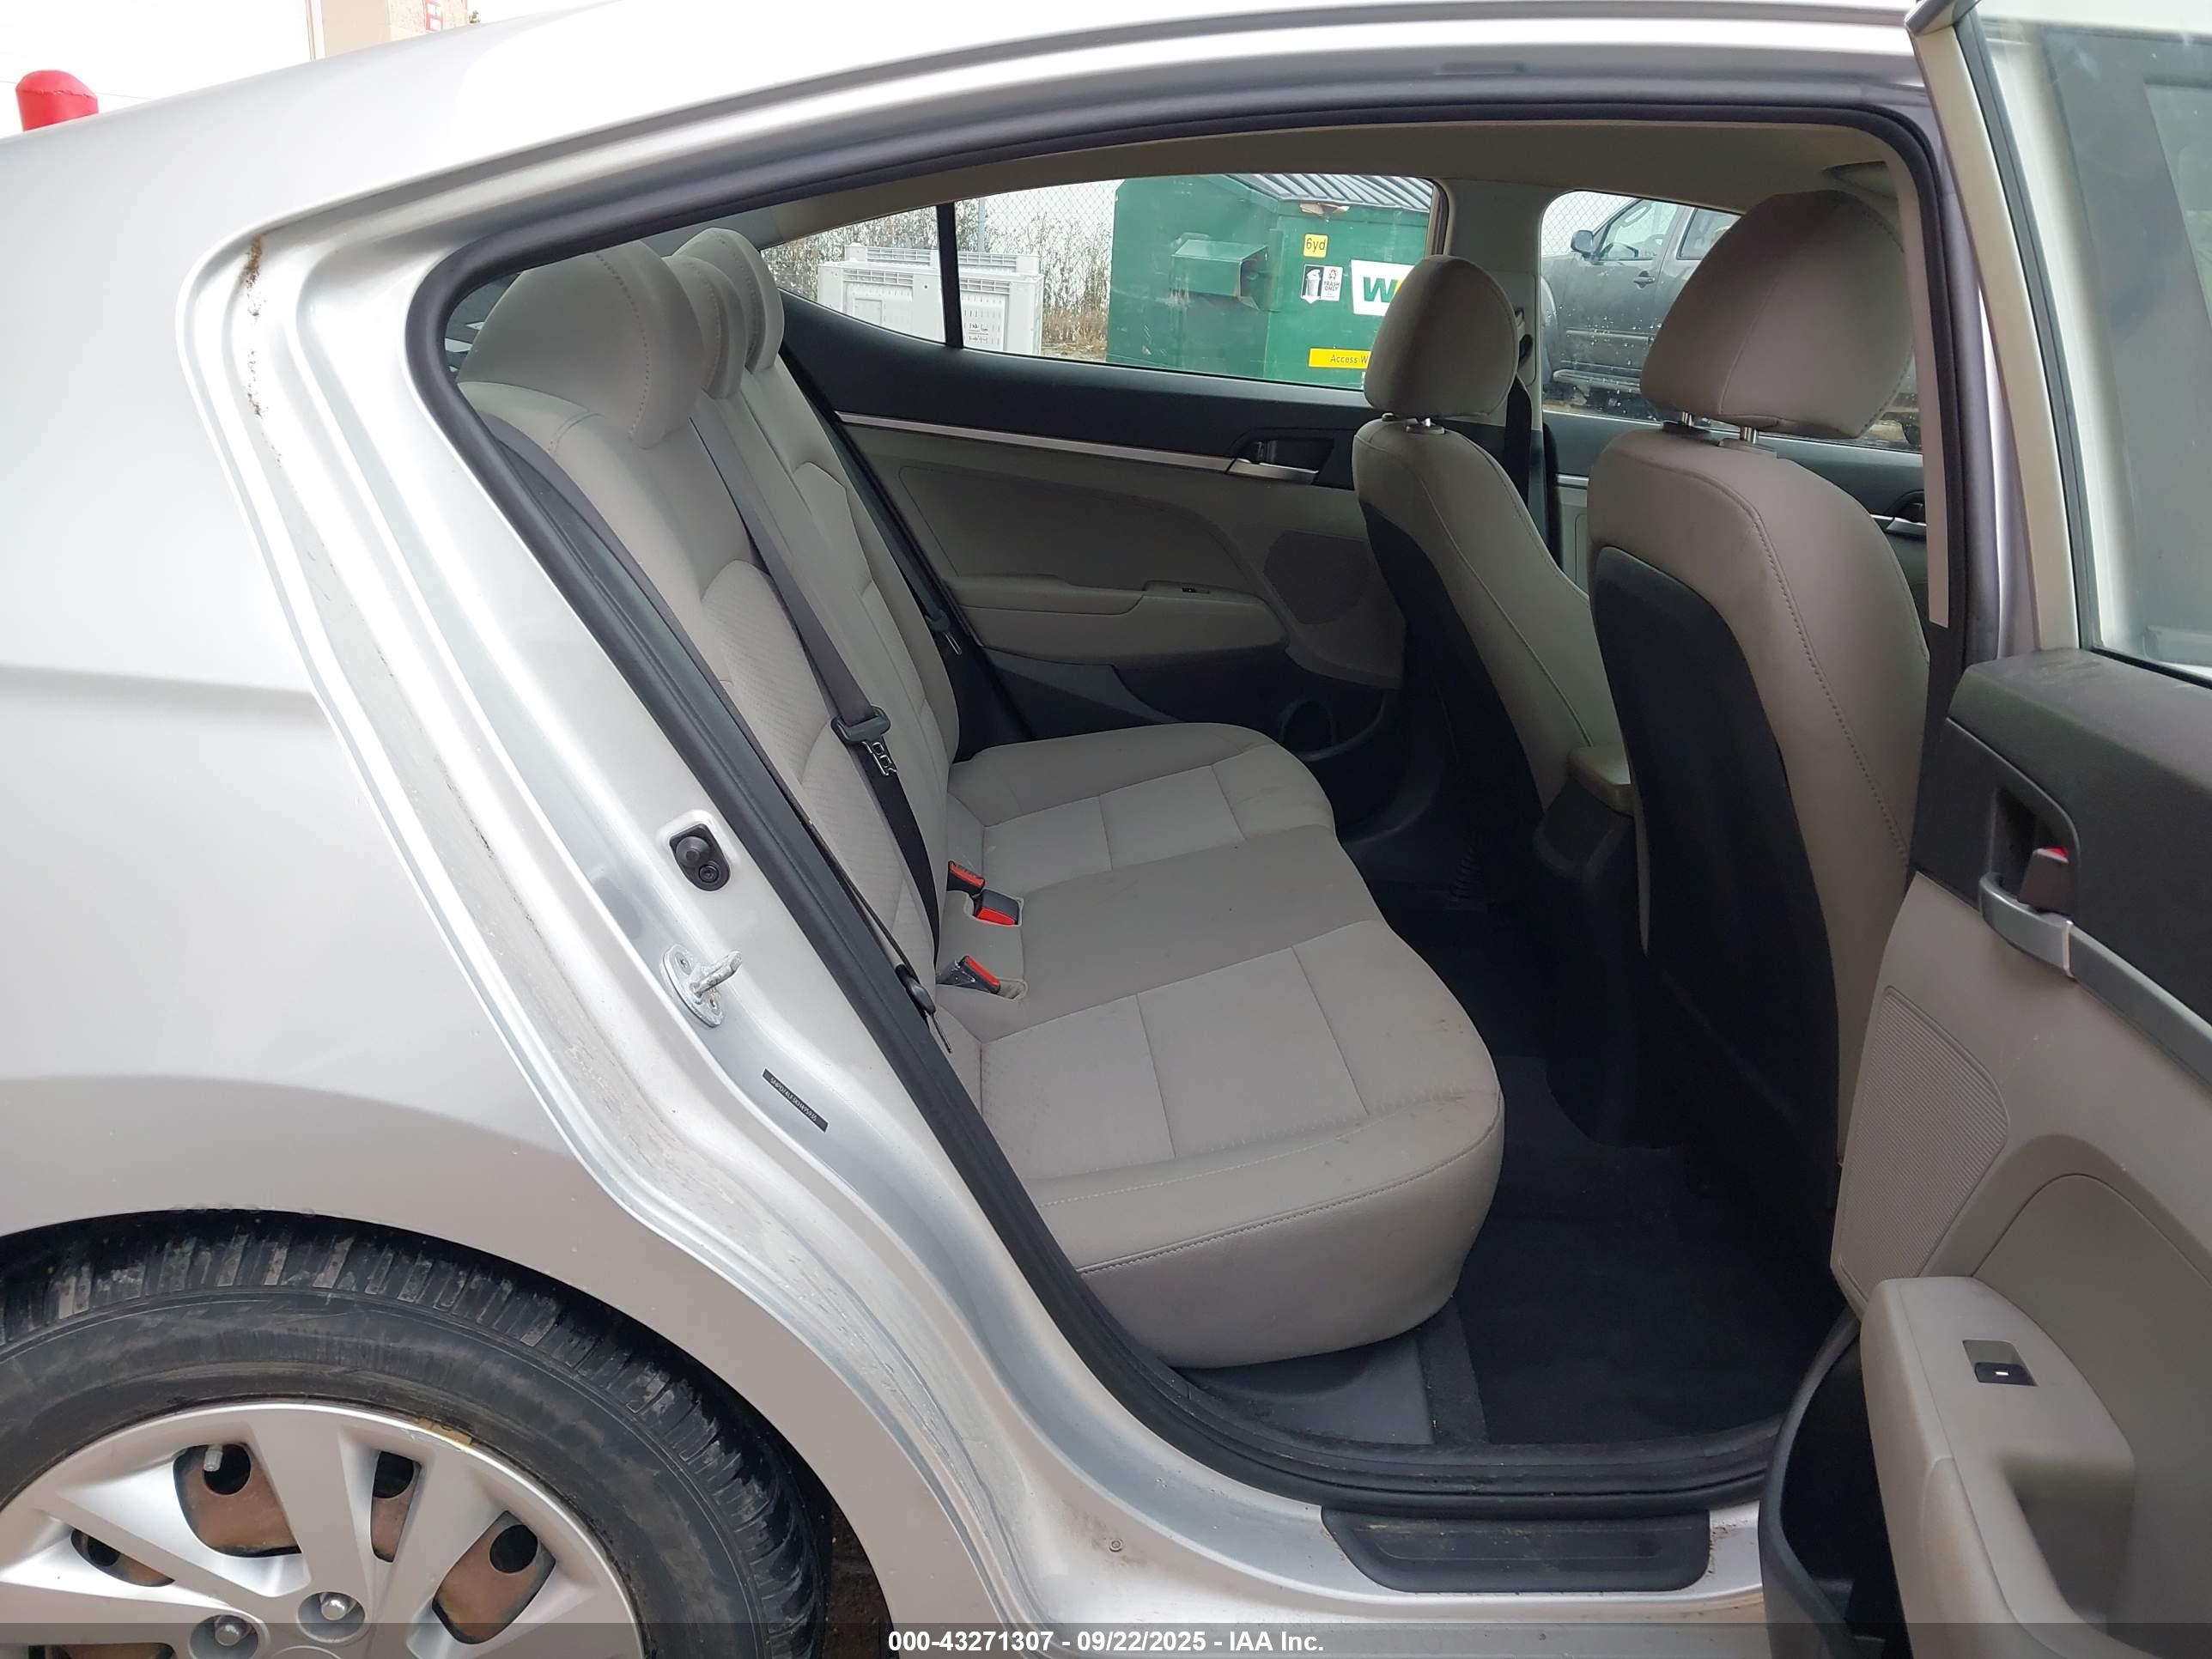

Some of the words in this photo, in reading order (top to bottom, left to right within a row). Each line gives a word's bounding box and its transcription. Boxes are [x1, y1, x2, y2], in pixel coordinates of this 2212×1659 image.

[1306, 237, 1327, 252] 6yd
[1363, 276, 1401, 303] W
[1330, 354, 1358, 364] Access
[1360, 355, 1369, 364] W
